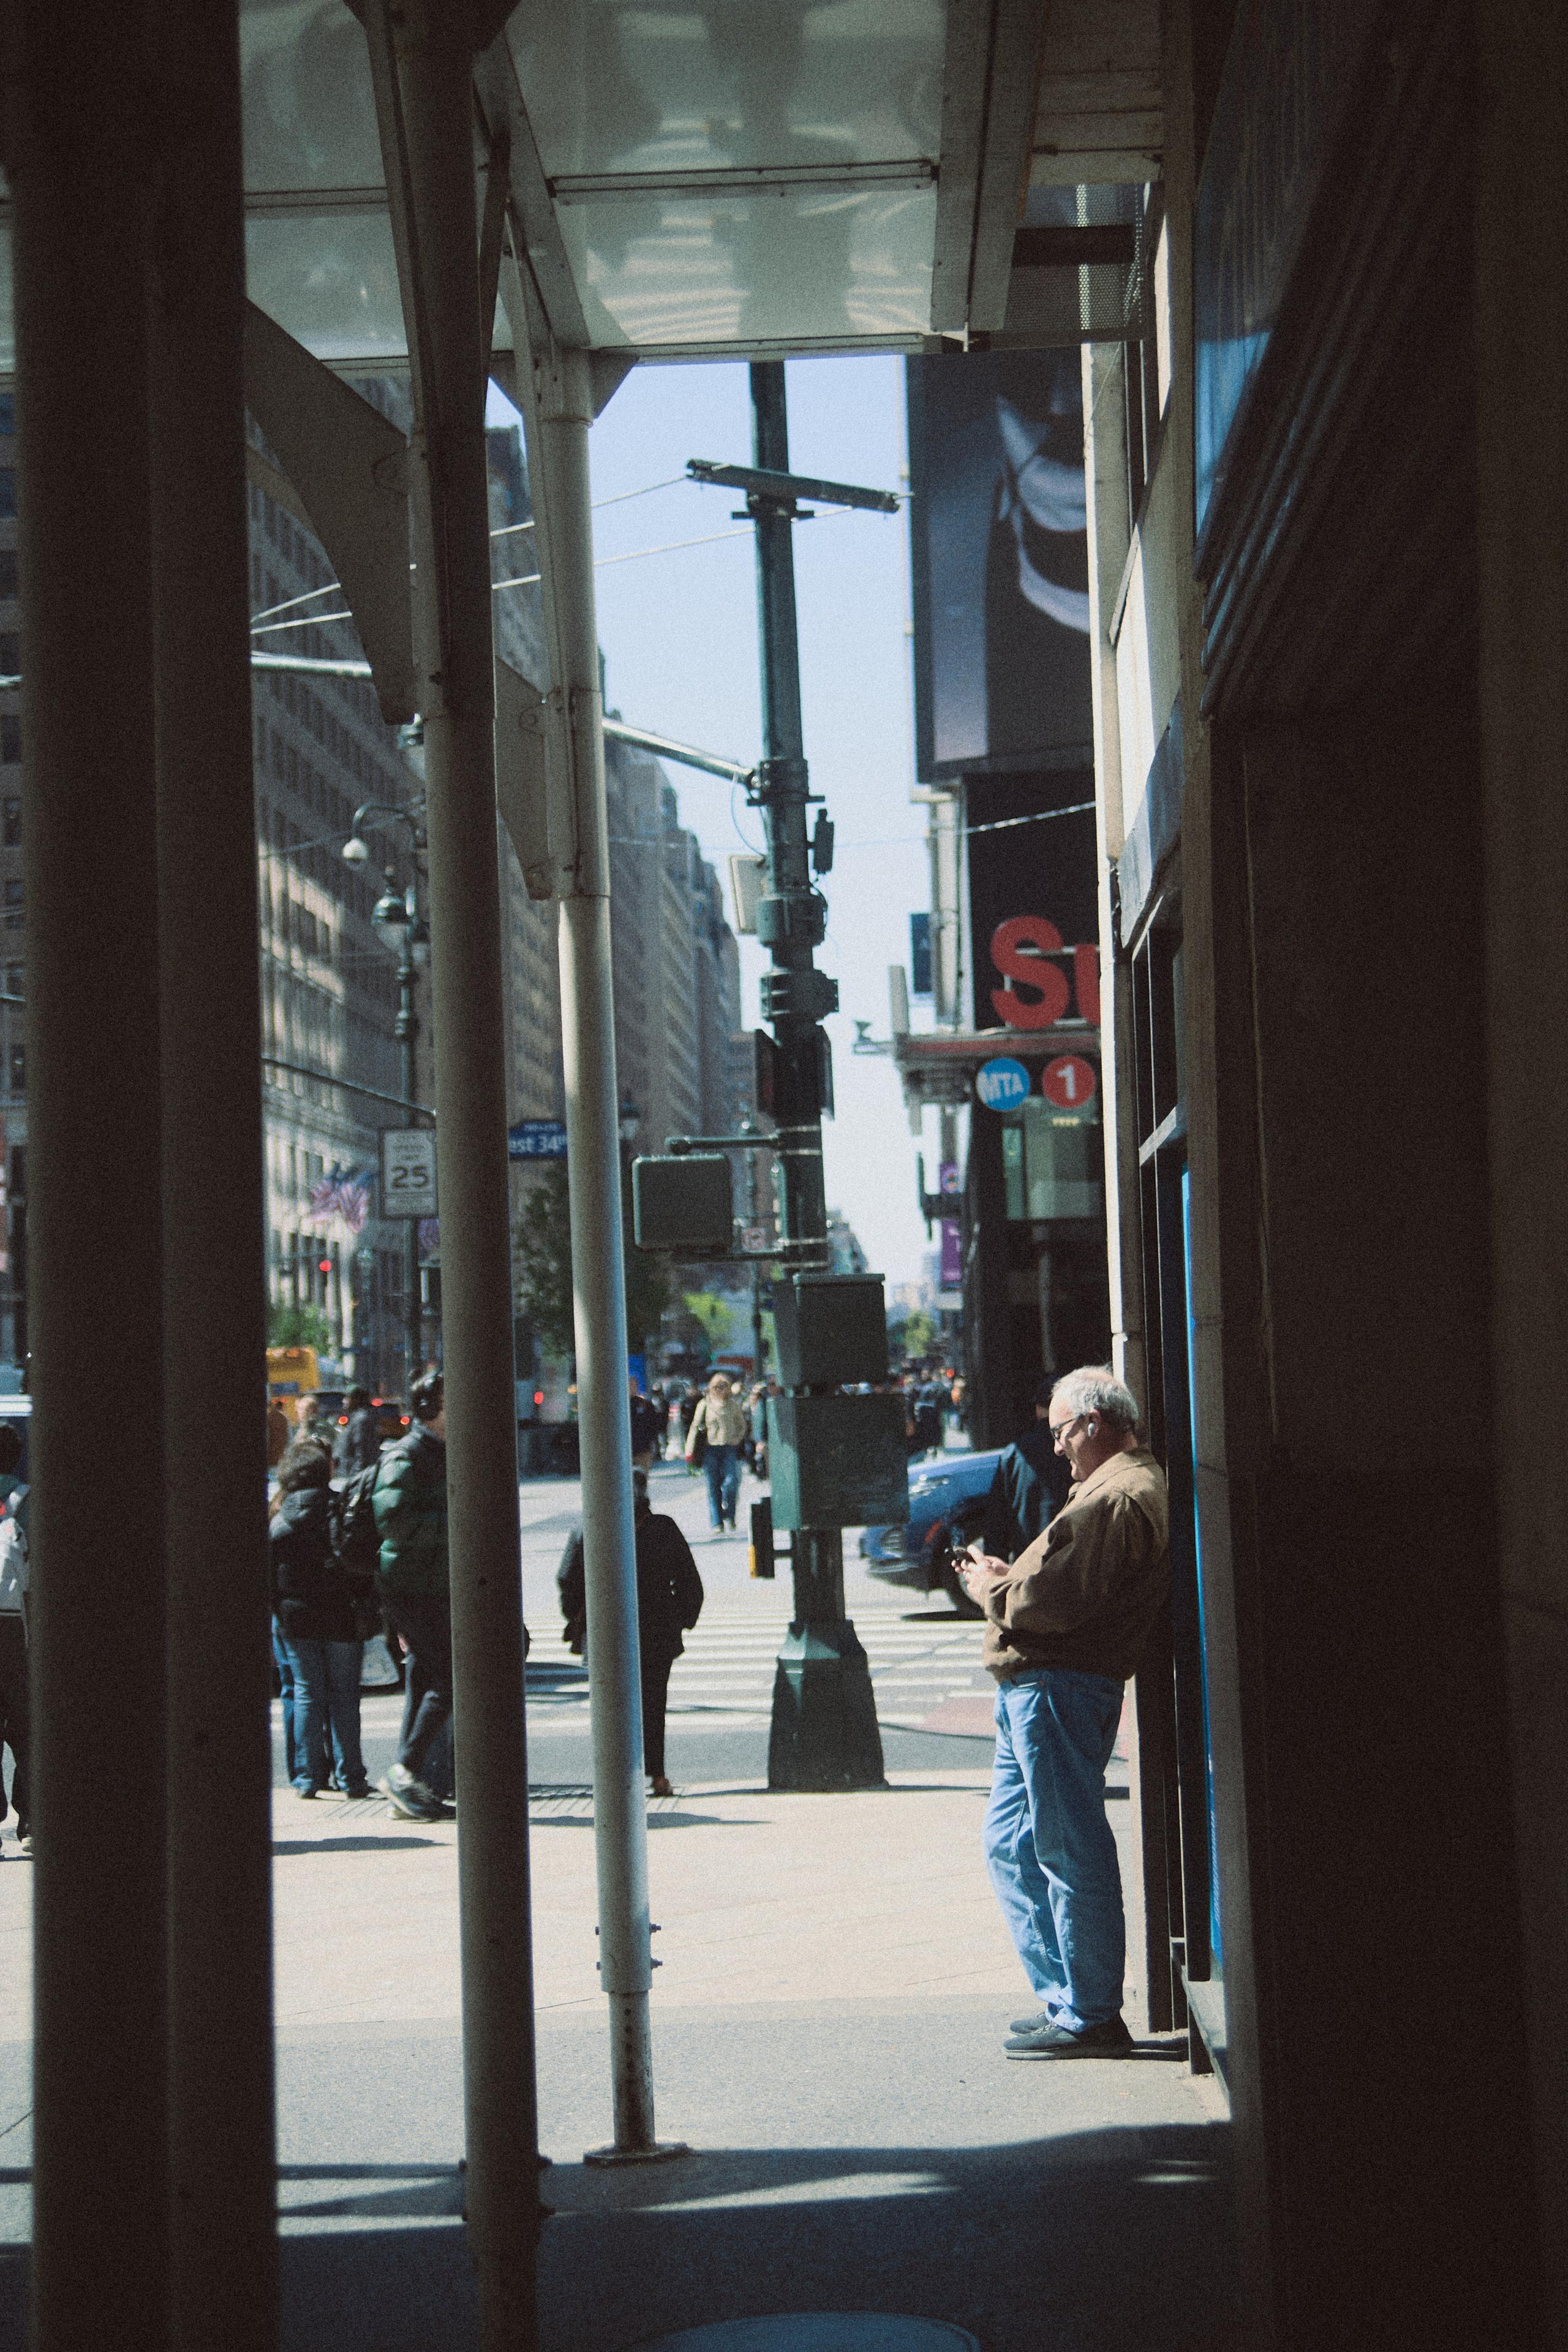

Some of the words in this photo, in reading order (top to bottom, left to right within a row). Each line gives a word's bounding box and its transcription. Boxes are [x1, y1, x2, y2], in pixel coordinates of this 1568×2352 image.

[978, 1071, 1023, 1102] MTA
[1057, 1065, 1076, 1099] 1
[392, 1165, 429, 1188] 25
